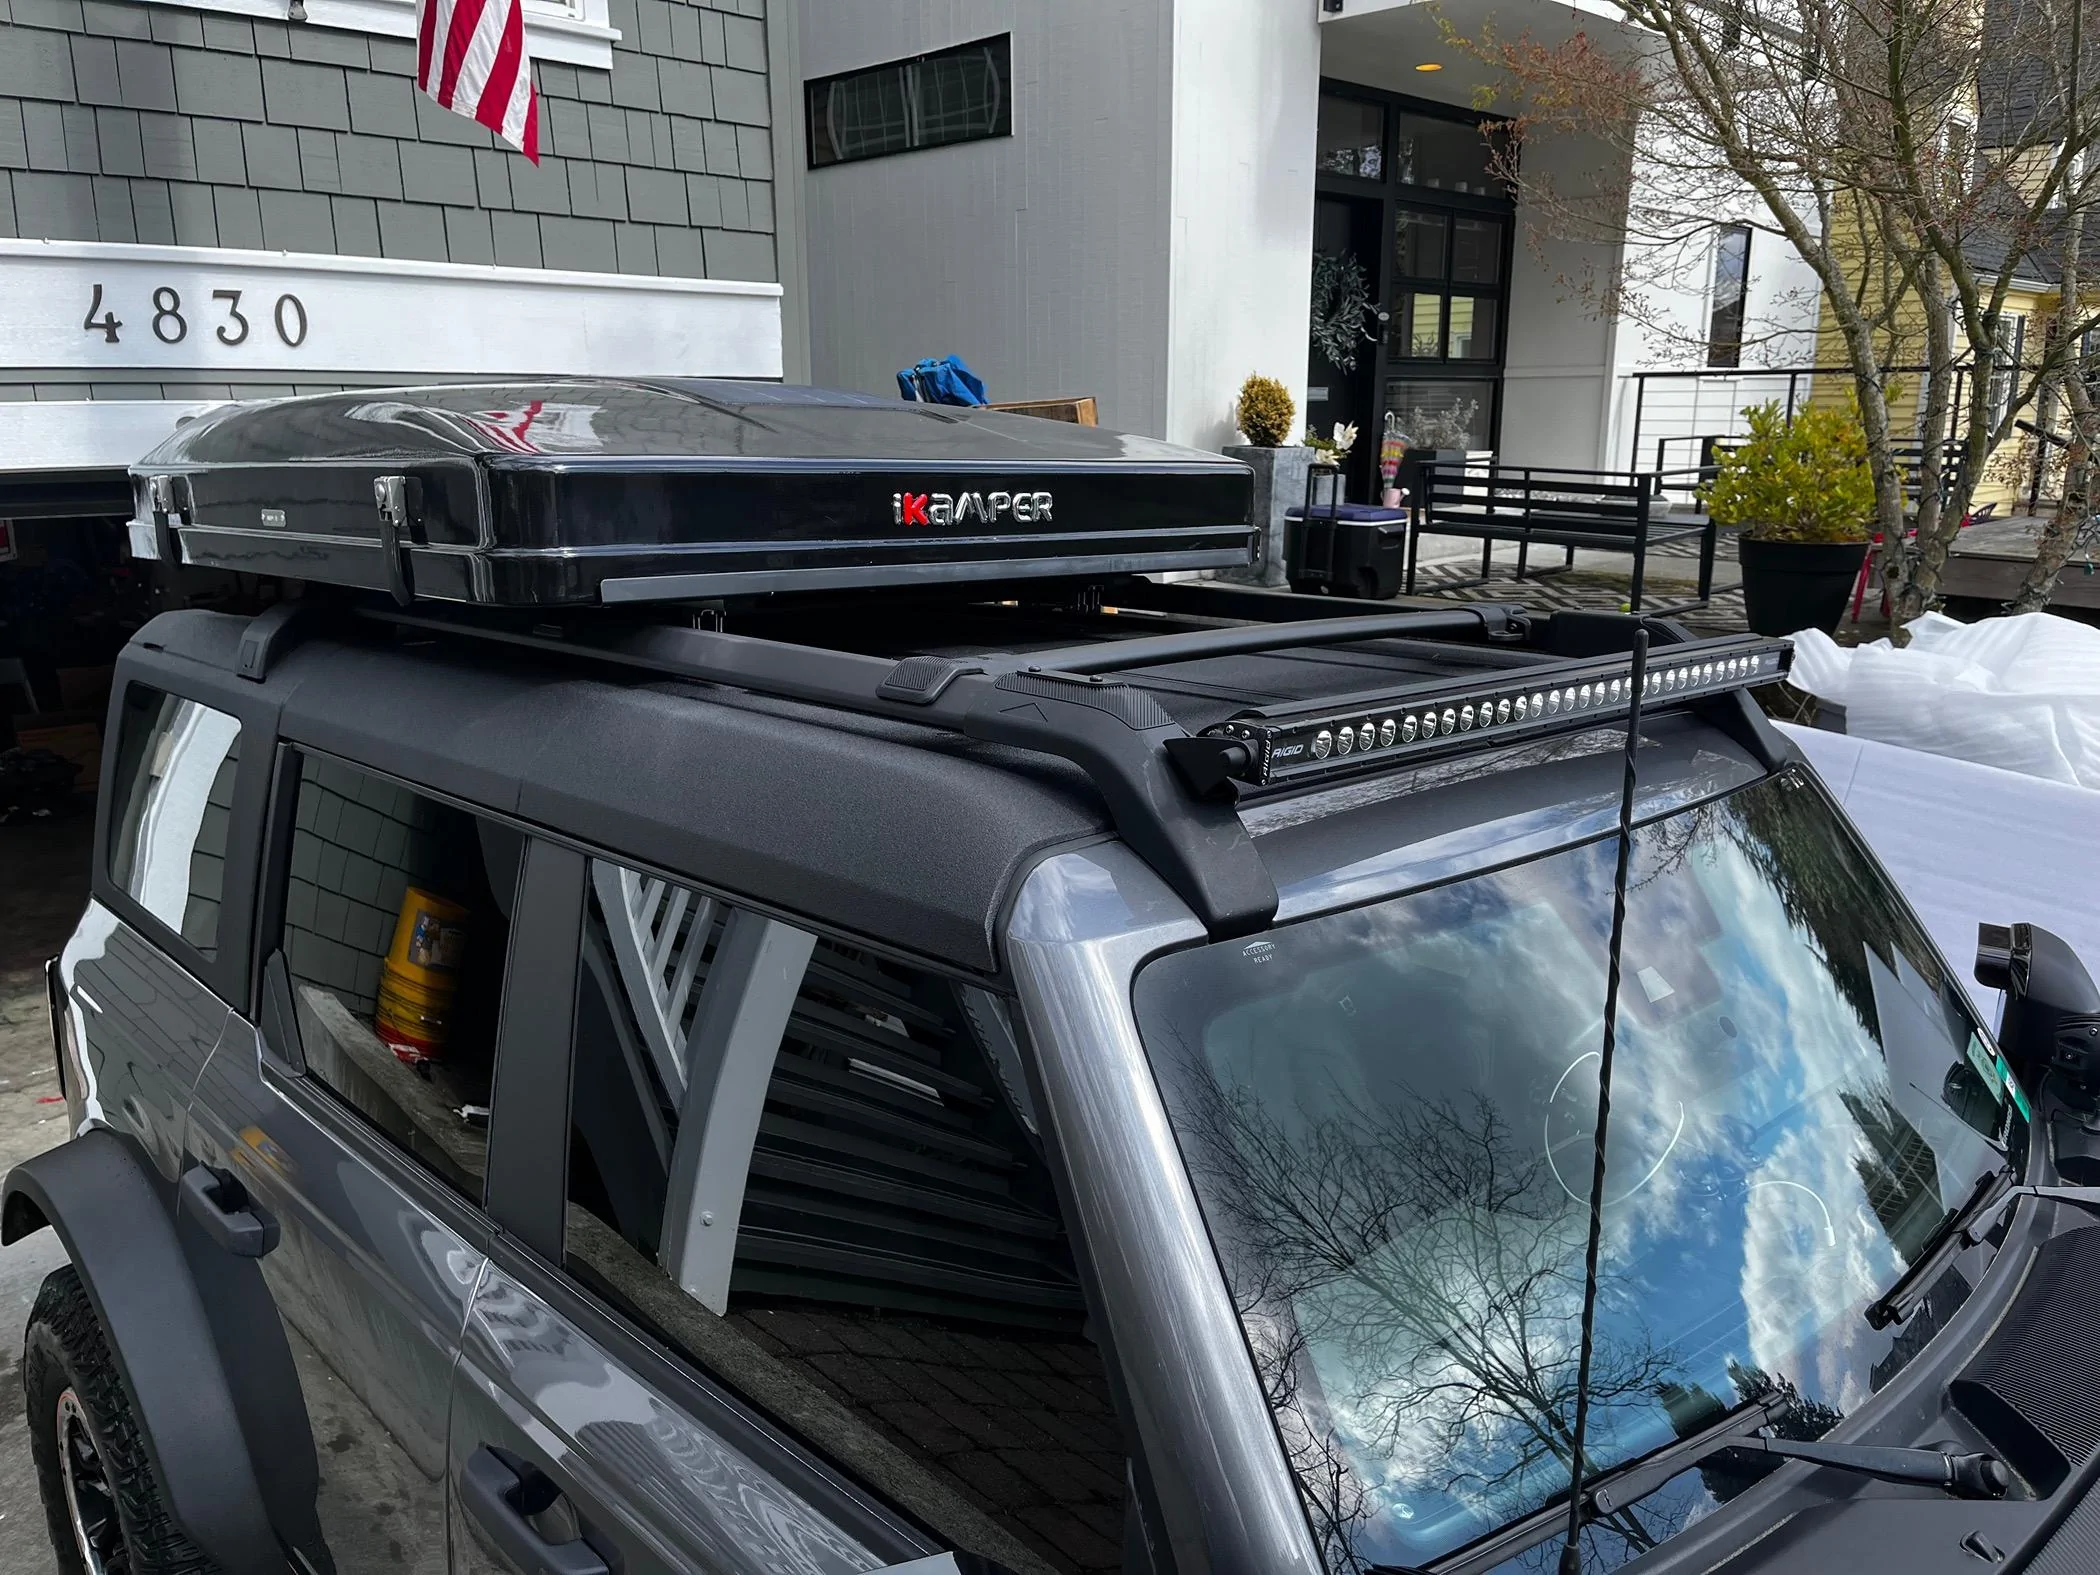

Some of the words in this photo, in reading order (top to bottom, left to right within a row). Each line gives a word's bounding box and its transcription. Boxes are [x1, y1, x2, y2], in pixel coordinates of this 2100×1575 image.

[83, 283, 308, 348] 4830
[1270, 744, 1304, 759] RIGID
[1242, 943, 1276, 957] ACCESSORY
[1253, 953, 1273, 963] READY
